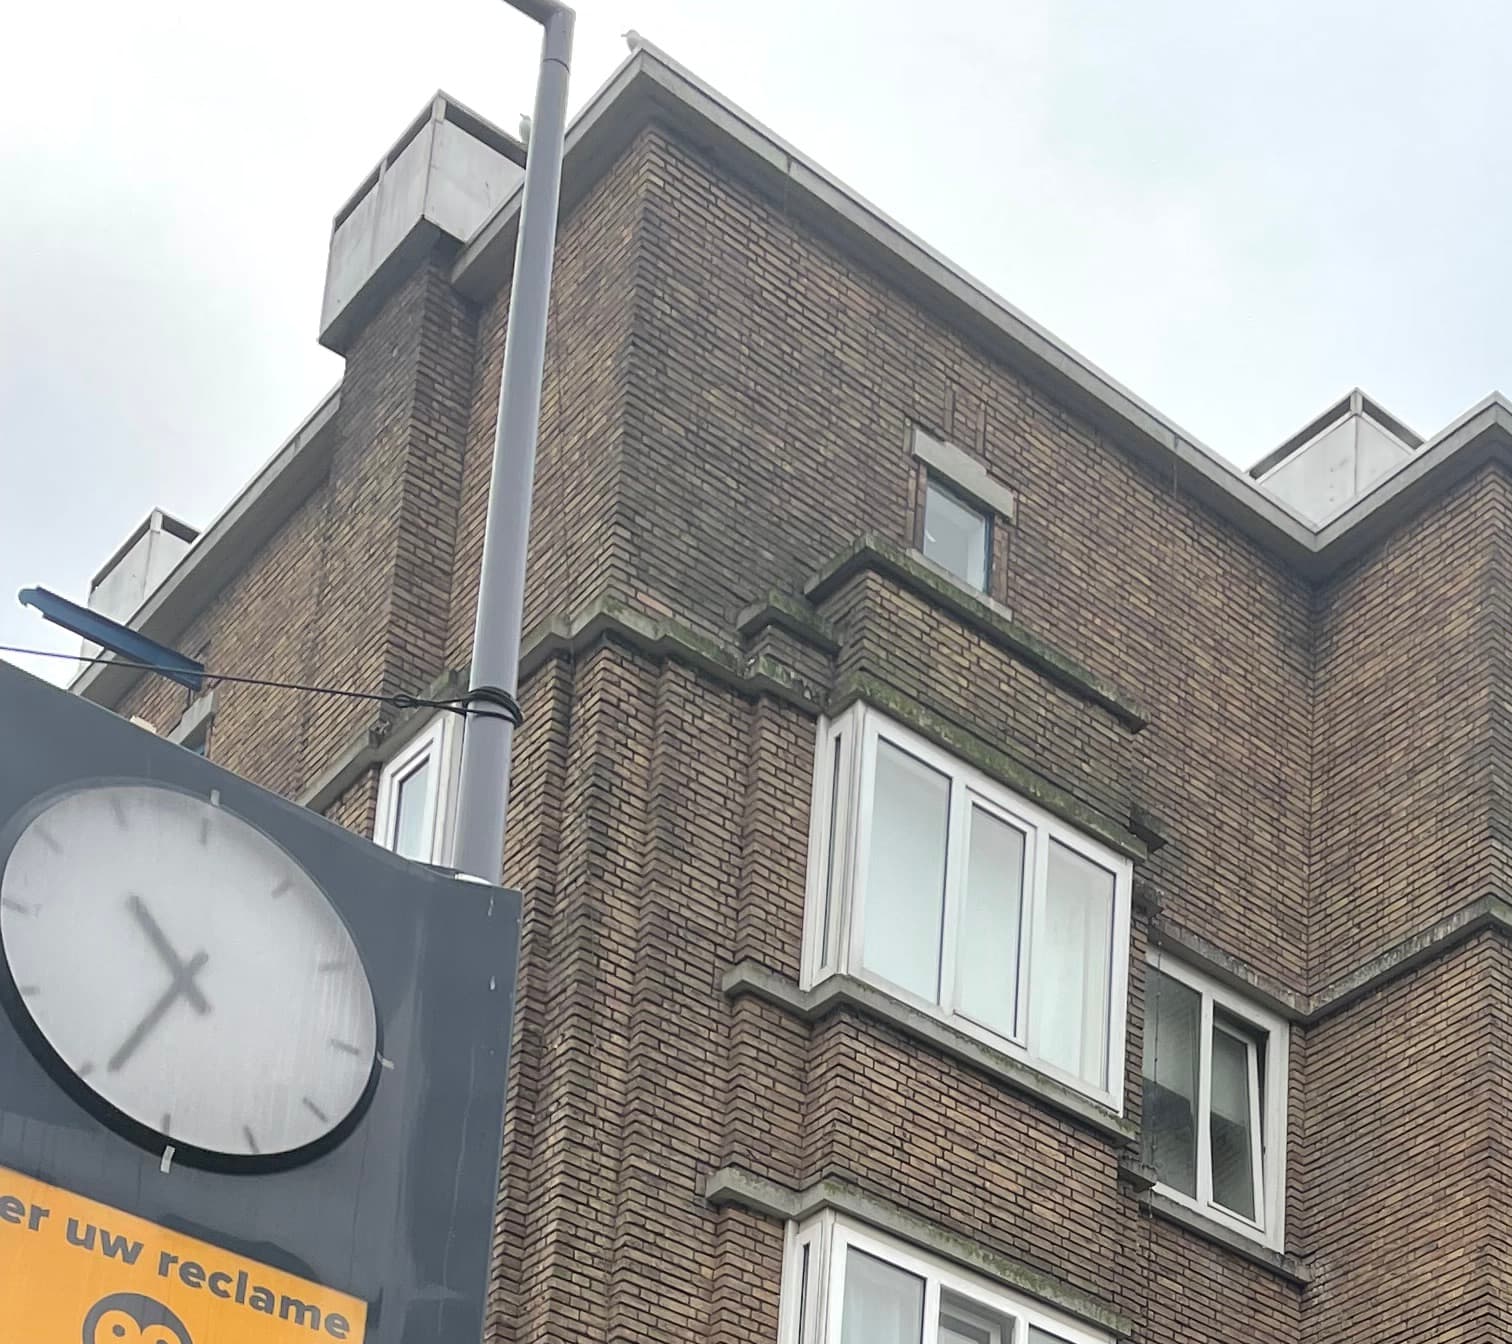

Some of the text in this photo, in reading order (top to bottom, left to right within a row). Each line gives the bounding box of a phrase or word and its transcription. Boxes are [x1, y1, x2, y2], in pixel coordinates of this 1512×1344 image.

[0, 1195, 352, 1341] er uw reclame
